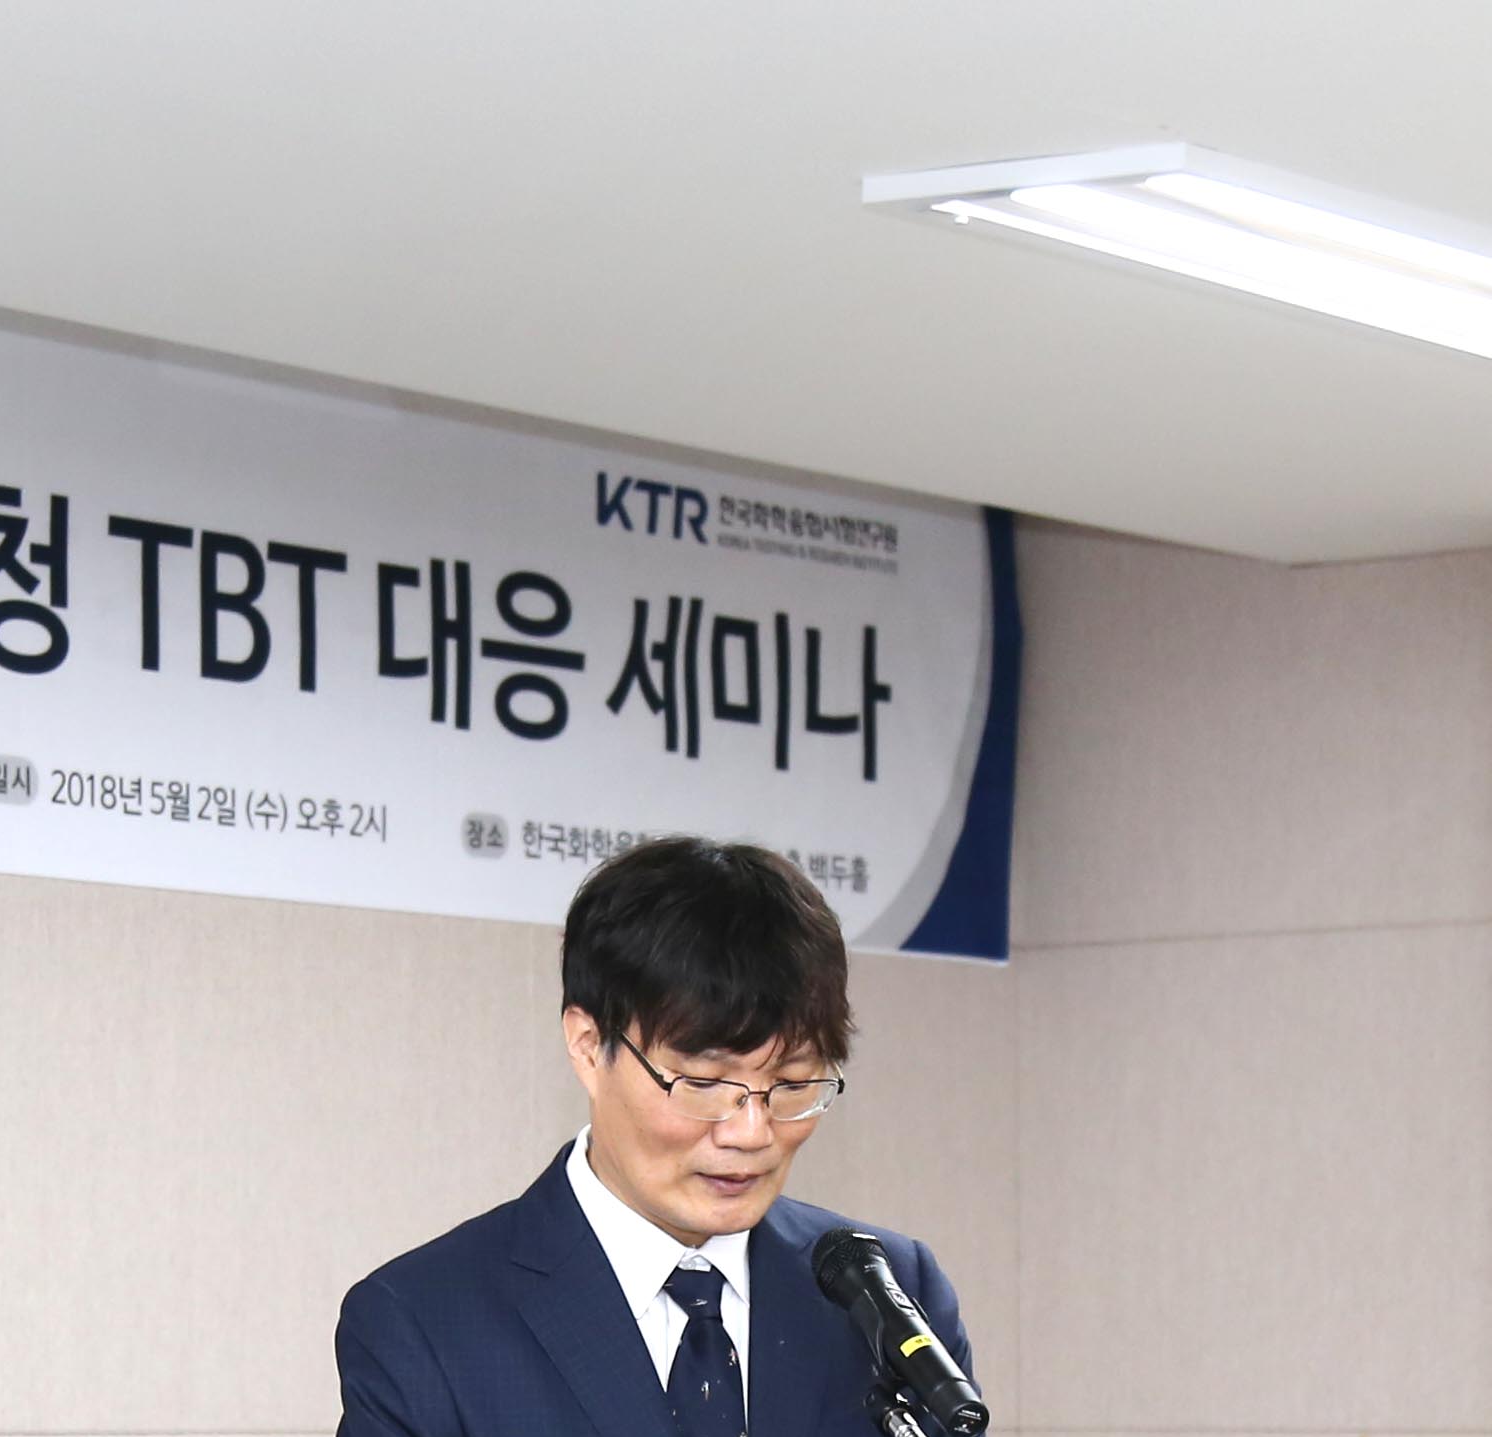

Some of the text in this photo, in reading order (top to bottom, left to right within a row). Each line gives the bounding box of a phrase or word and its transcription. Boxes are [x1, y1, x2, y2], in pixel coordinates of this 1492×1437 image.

[596, 471, 709, 545] KTR
[107, 514, 348, 694] TBT
[377, 557, 586, 742] 대응
[605, 595, 892, 783] 세미나
[50, 768, 388, 843] 2018년 5월 2일 (수) 오후 2시
[466, 818, 504, 849] 장소
